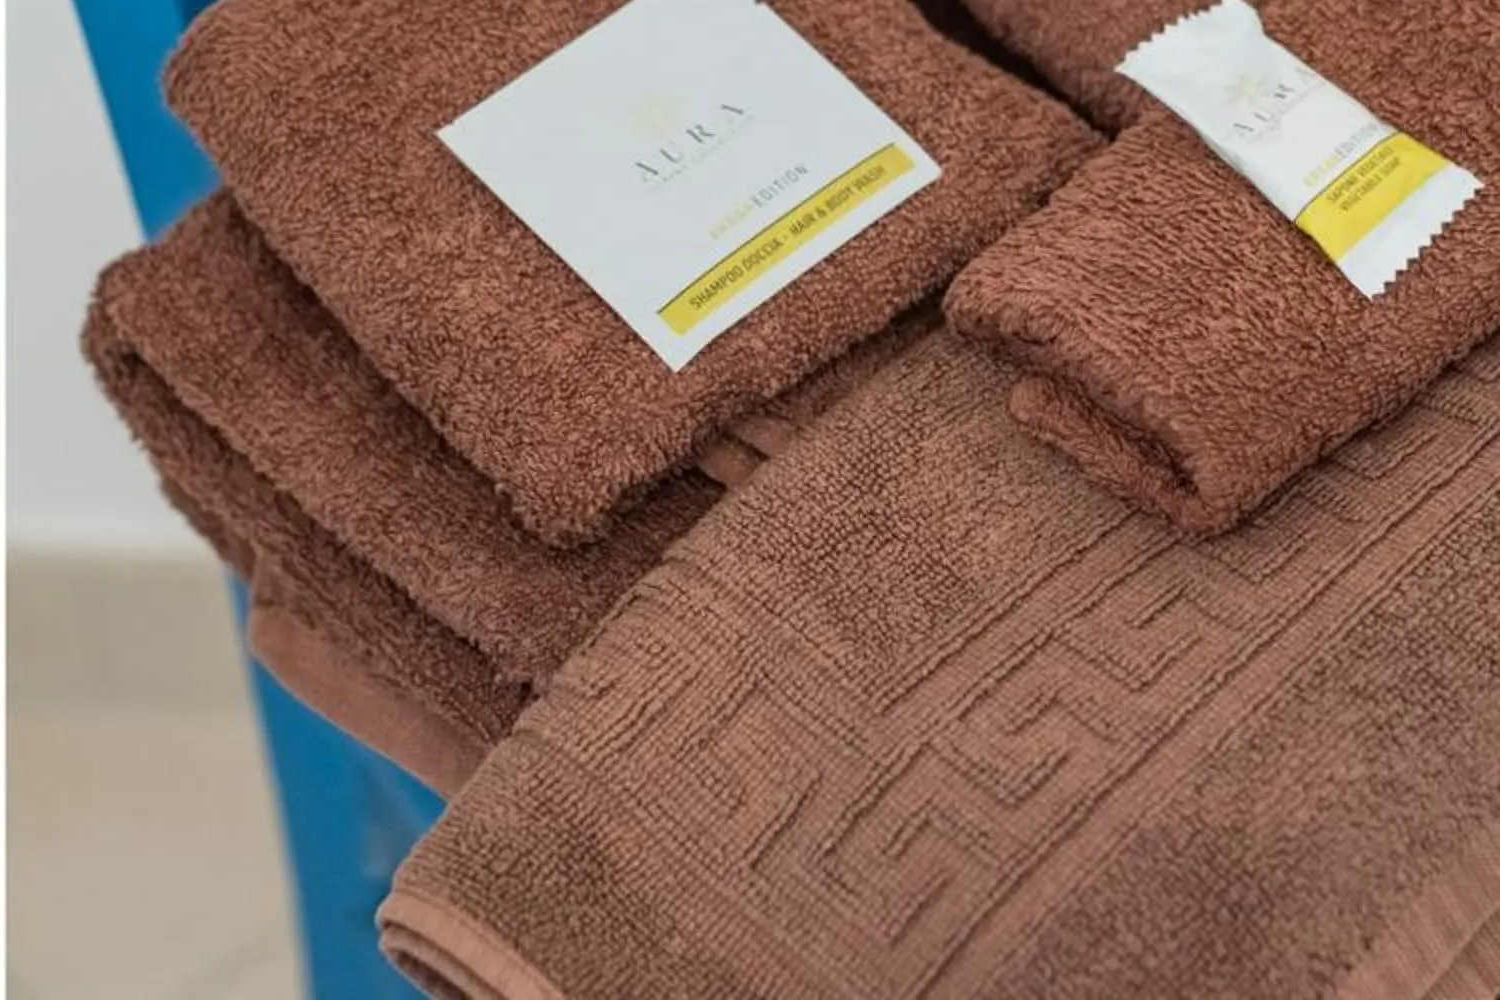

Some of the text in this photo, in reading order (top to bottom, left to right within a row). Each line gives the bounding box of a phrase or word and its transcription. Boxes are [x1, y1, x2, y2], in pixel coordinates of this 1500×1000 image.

[689, 265, 745, 309] SHAMPOO
[742, 237, 785, 272] DOCCIA
[789, 211, 818, 237] HAIR
